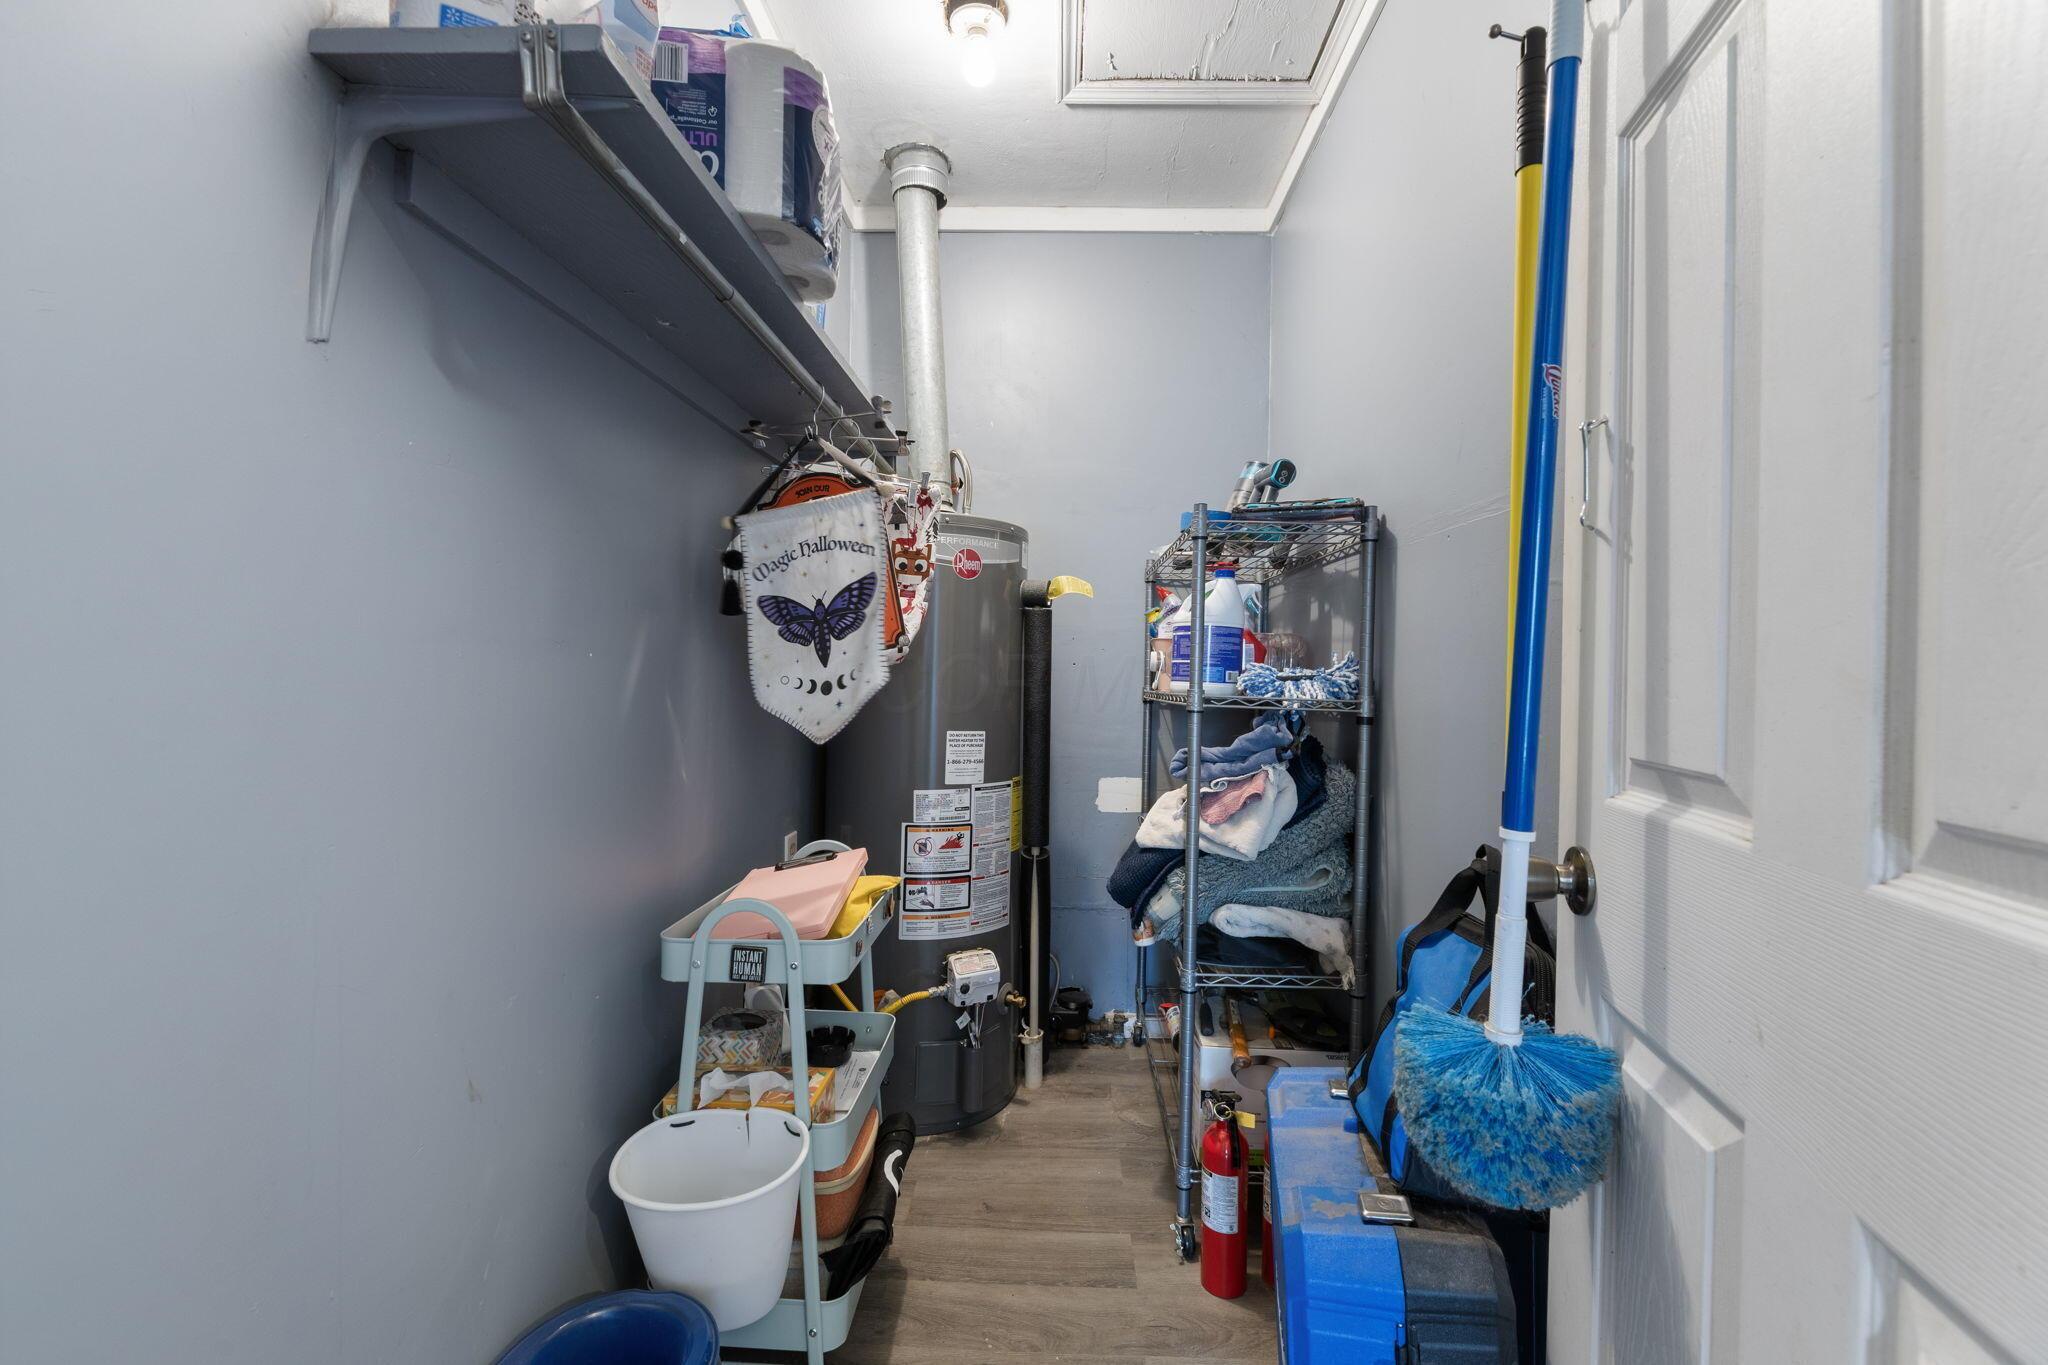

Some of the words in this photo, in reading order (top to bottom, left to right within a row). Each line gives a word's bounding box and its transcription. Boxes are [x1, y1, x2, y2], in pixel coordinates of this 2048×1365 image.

[795, 488, 813, 499] JOIN
[813, 484, 830, 493] OUR
[752, 549, 798, 582] Magic
[955, 547, 981, 575] Rheem
[733, 949, 763, 963] INSTANT
[733, 962, 762, 976] HUMAN
